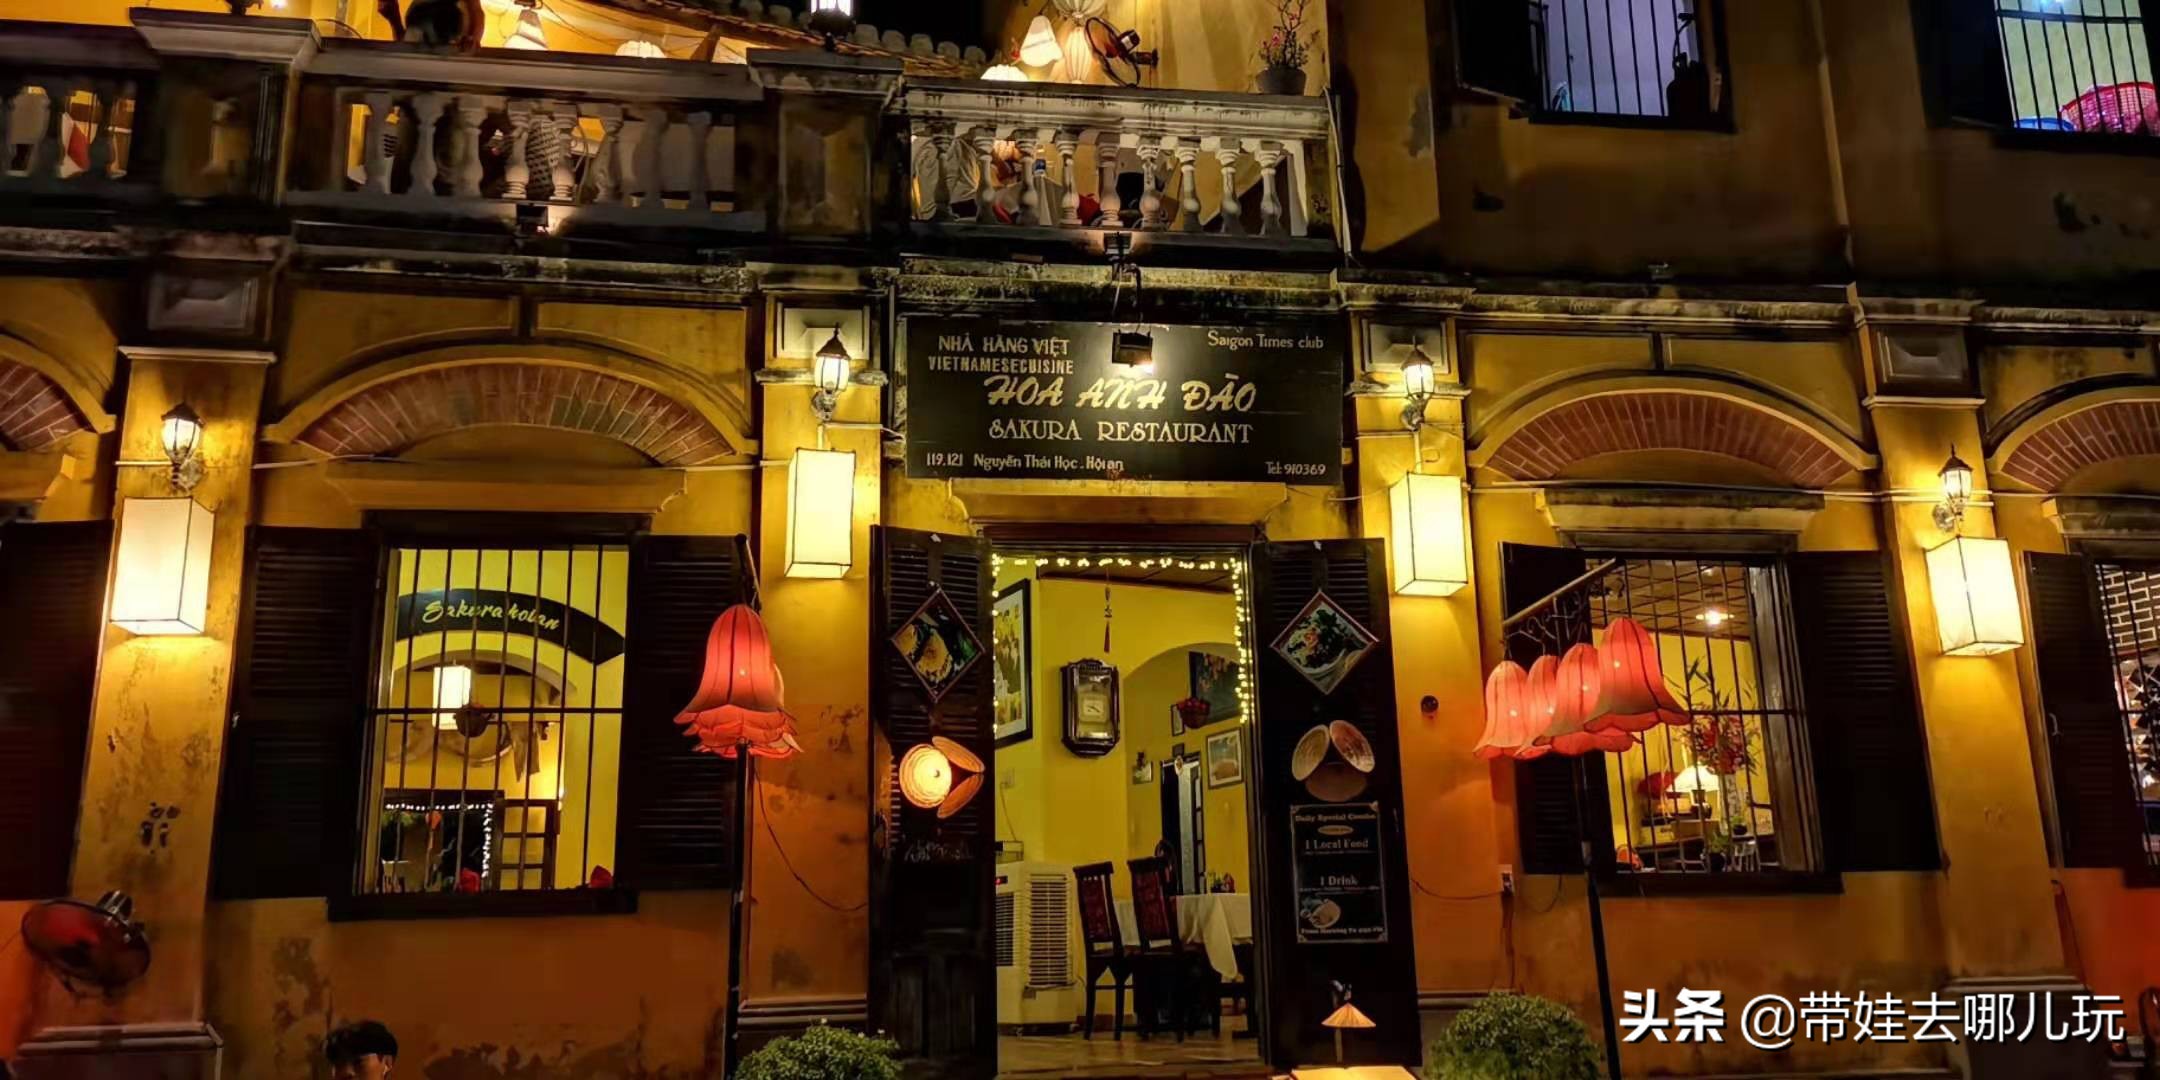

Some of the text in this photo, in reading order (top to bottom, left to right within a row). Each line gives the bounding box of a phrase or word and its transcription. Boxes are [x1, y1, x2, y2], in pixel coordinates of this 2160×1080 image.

[1032, 336, 1070, 358] VIỆT
[1207, 329, 1324, 351] Saigon Times club
[984, 375, 1063, 407] HOA
[1075, 376, 1168, 410] ANH
[988, 418, 1253, 444] SAKURA RESTAURANT
[1313, 839, 1341, 850] Local
[1328, 875, 1358, 886] Drink
